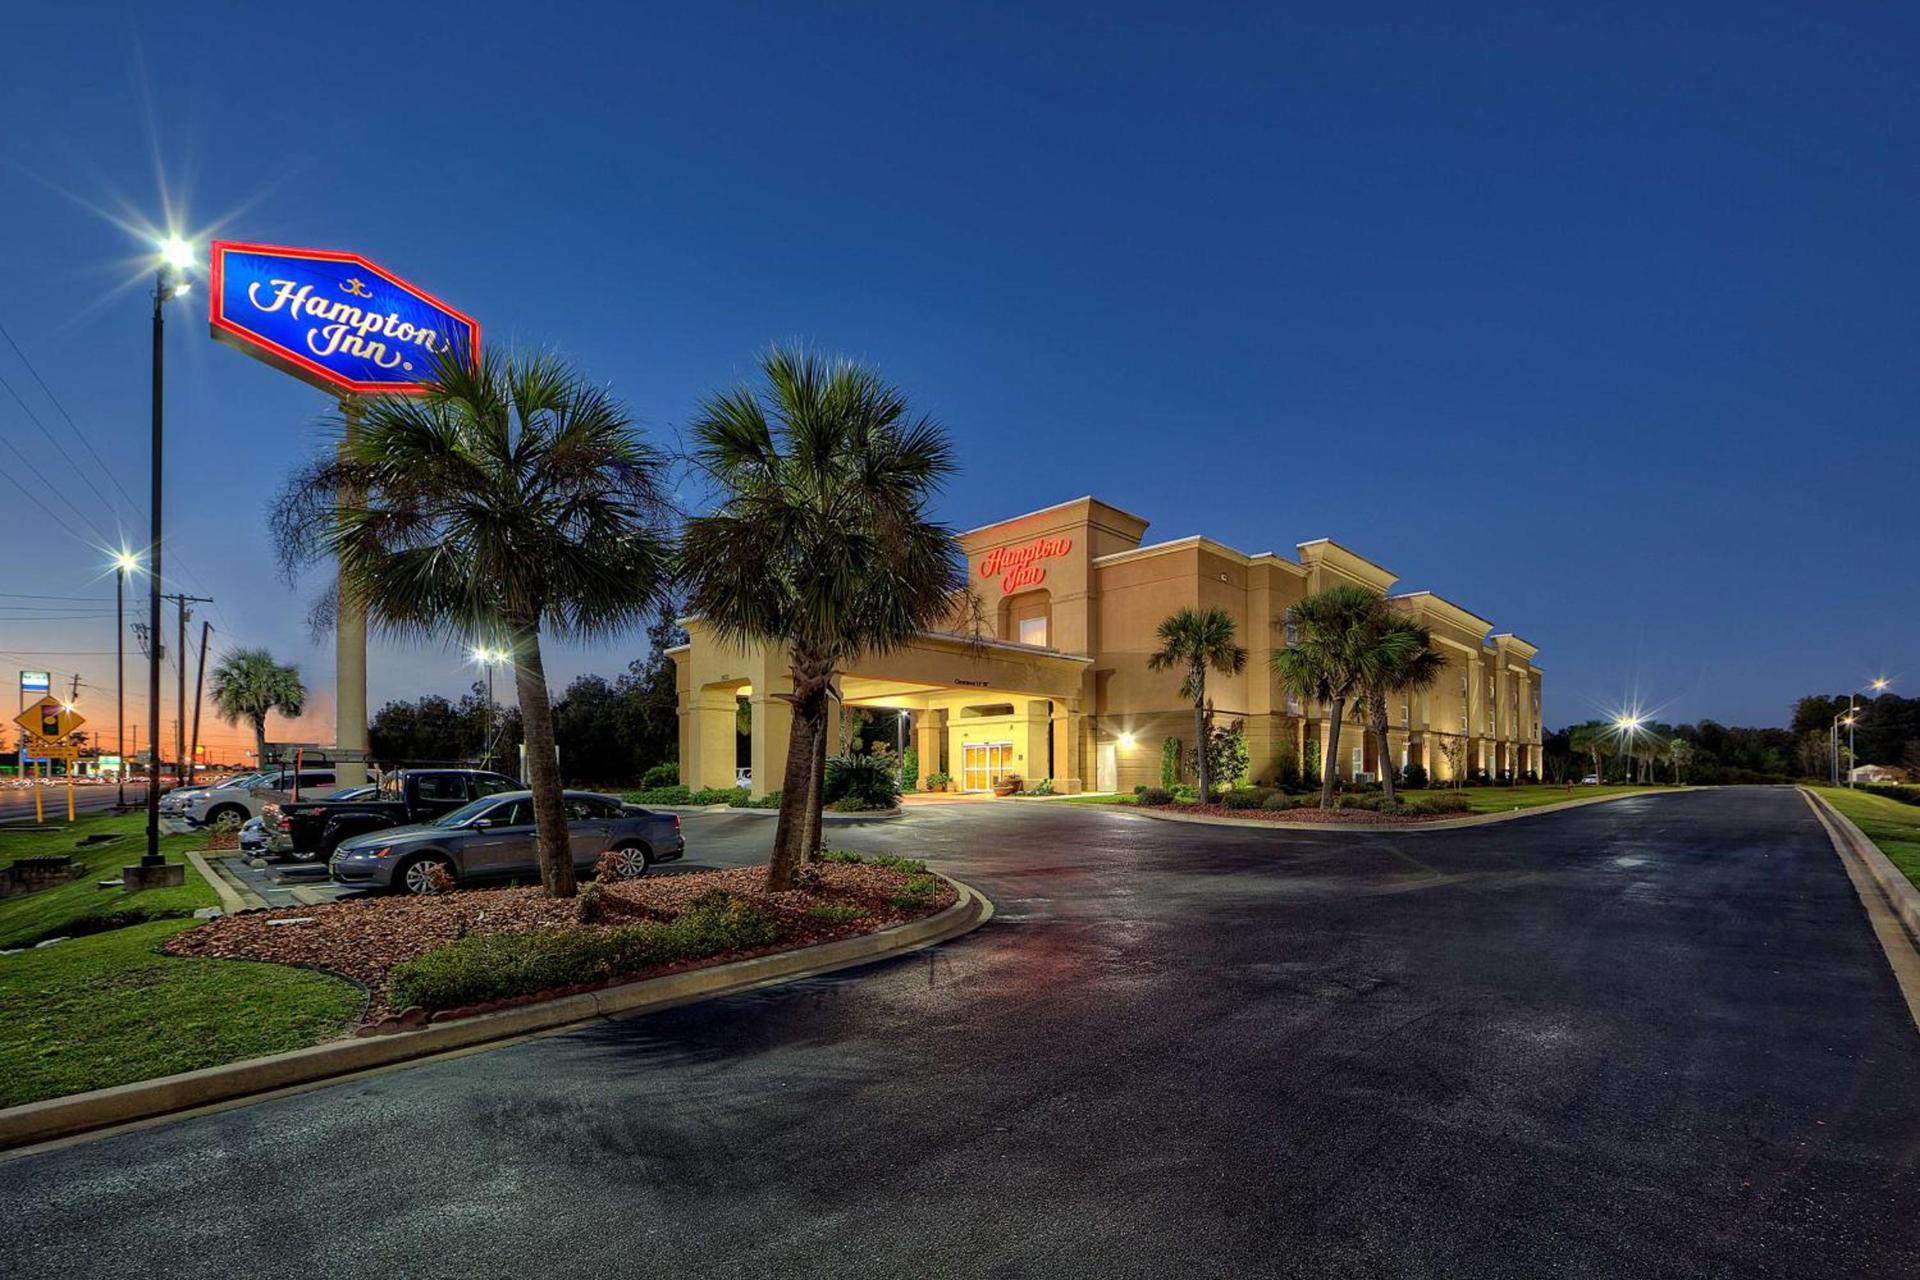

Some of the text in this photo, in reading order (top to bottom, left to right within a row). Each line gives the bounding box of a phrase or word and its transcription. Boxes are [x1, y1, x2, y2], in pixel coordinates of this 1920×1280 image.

[248, 278, 449, 353] Hampton
[306, 324, 401, 368] Inn
[978, 537, 1072, 579] Hampton
[1001, 564, 1046, 594] Inn
